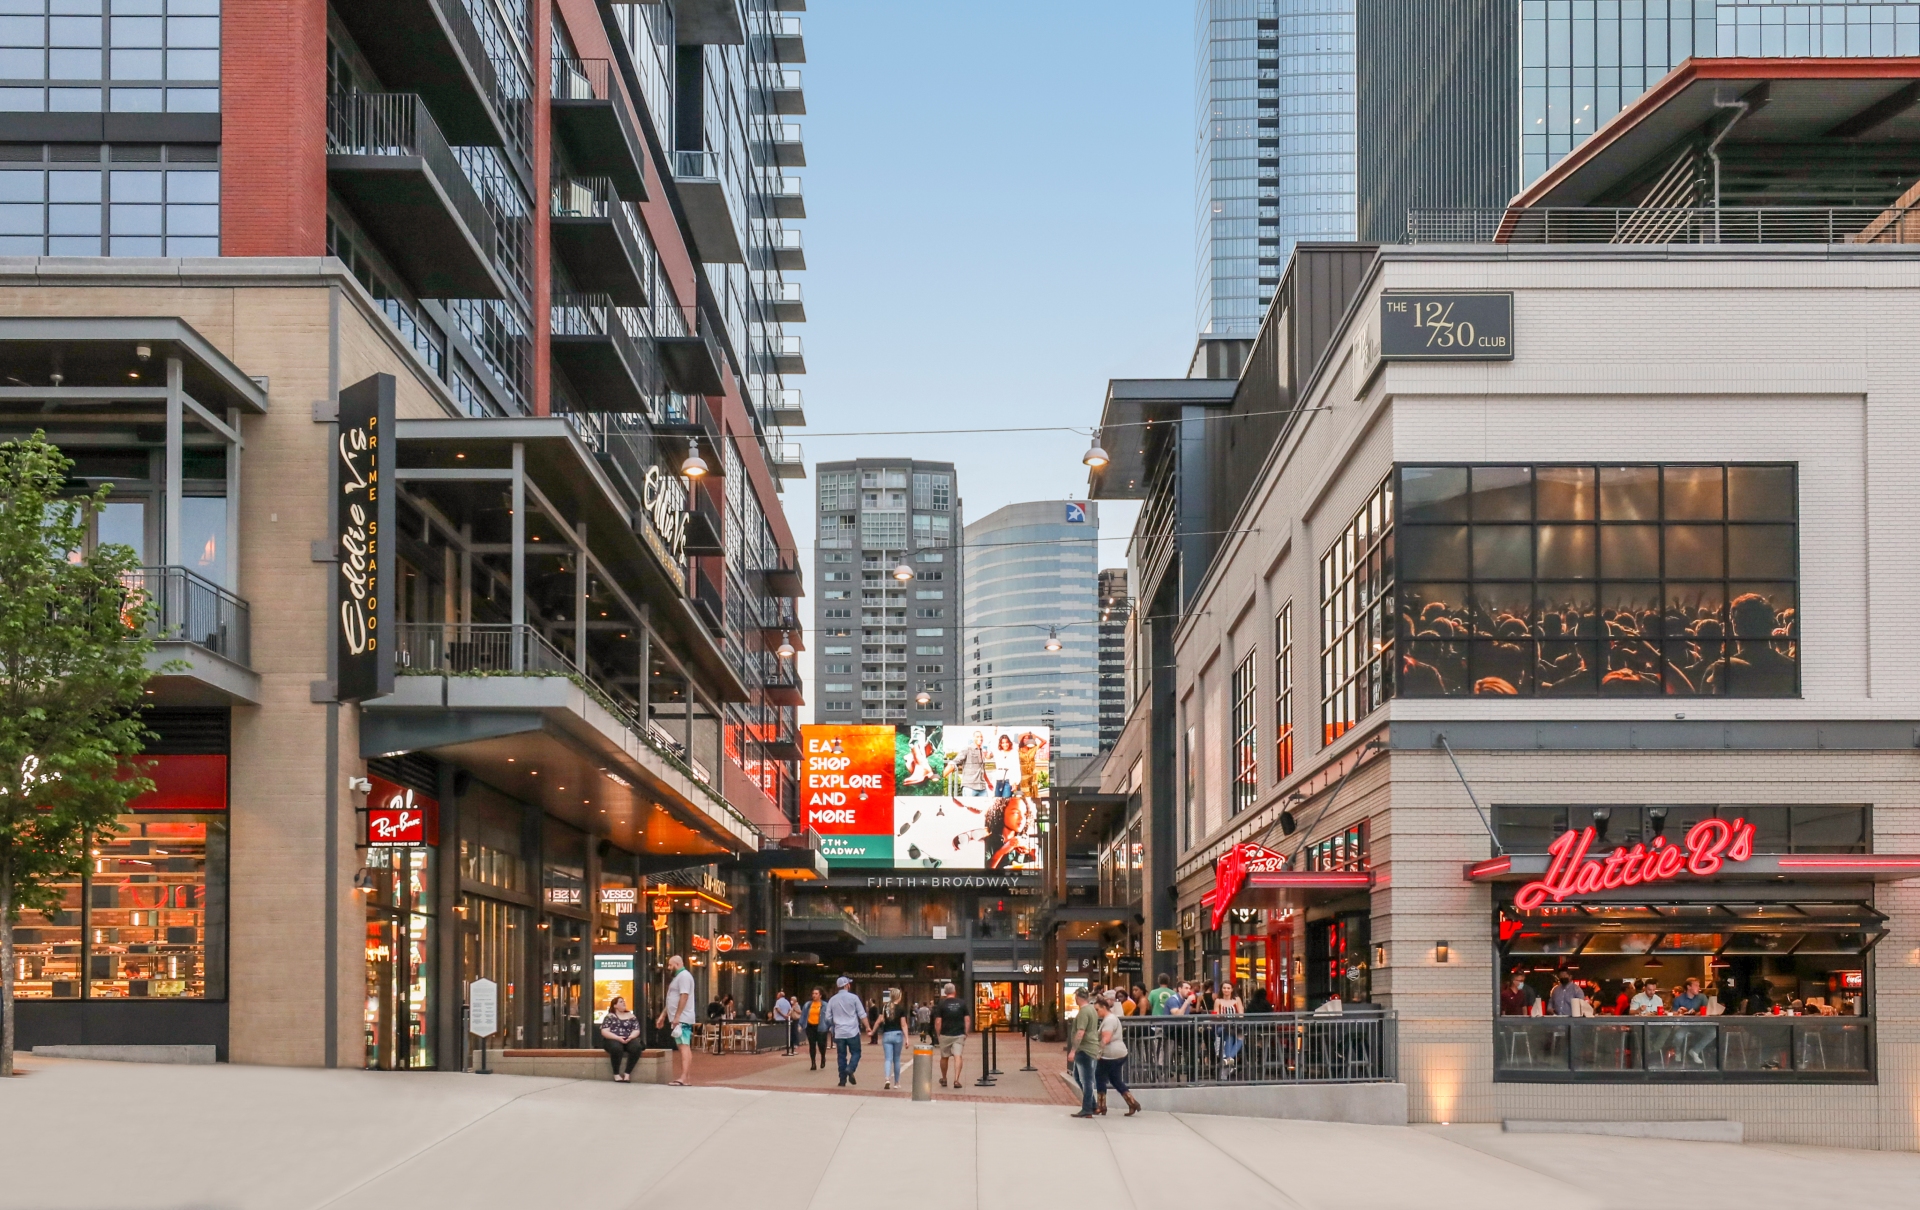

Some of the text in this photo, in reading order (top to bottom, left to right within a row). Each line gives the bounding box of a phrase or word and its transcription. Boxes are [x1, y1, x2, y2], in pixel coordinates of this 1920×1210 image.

[1386, 302, 1407, 312] THE
[1478, 337, 1506, 347] CLUB
[339, 427, 367, 656] Eddie V's
[368, 417, 377, 651] PRIME SEAFOOD
[809, 792, 846, 806] AND
[820, 839, 849, 847] FTH+
[822, 847, 866, 856] OADWAY
[1514, 817, 1756, 911] Hattie B's
